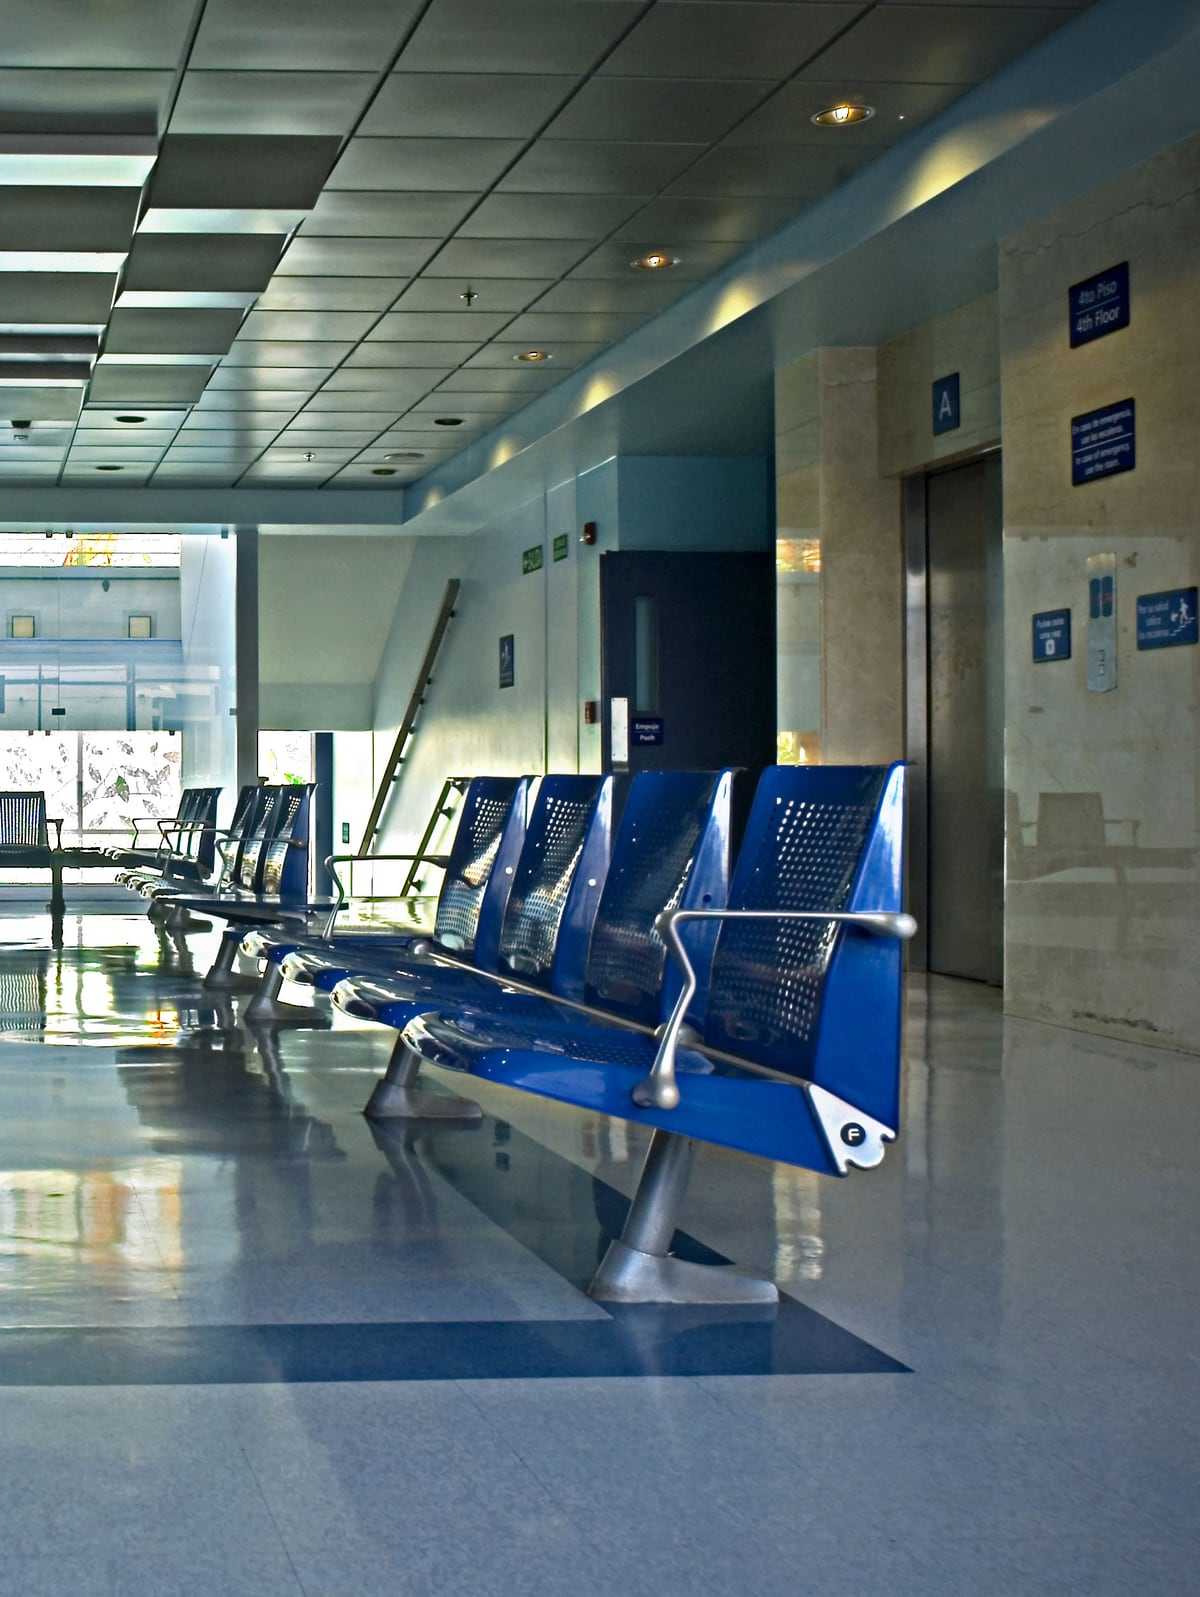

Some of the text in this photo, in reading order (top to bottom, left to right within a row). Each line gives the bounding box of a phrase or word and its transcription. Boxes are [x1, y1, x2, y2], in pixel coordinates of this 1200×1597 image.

[1097, 281, 1117, 299] Piso
[1076, 307, 1120, 333] 4th Floor
[939, 391, 952, 421] A
[848, 1128, 860, 1141] F
